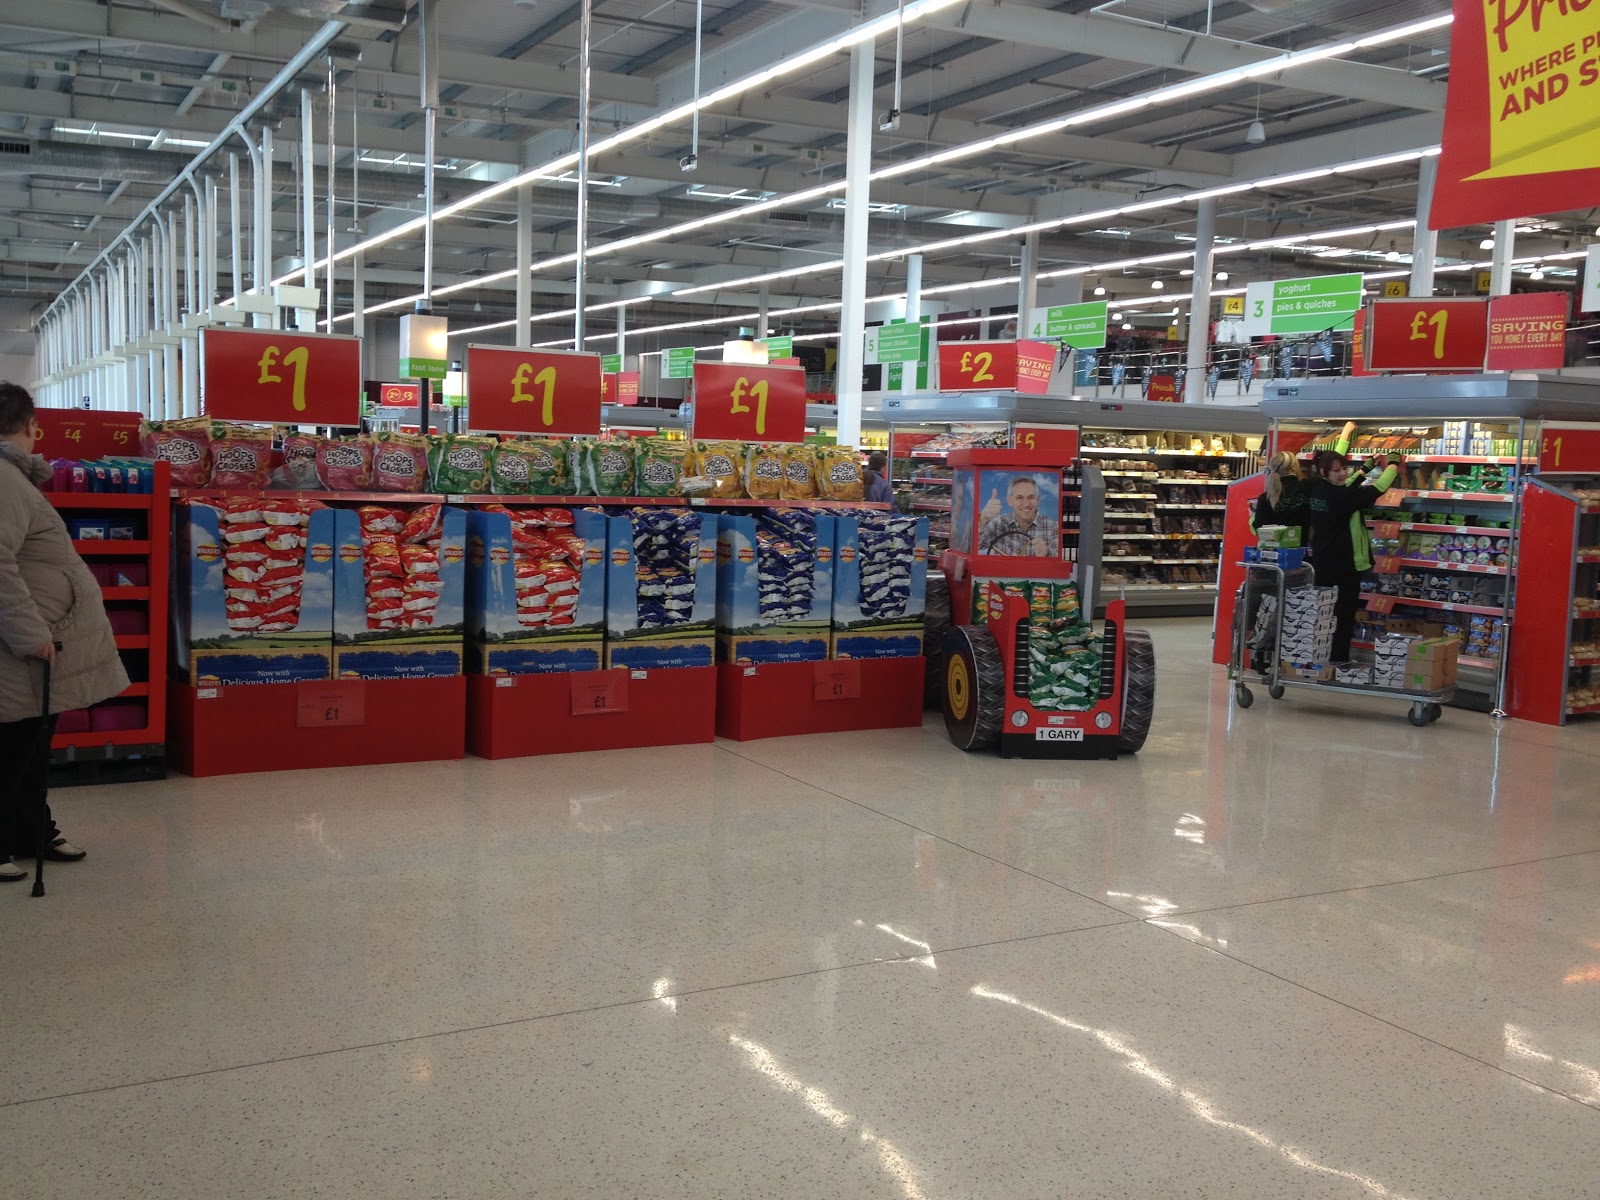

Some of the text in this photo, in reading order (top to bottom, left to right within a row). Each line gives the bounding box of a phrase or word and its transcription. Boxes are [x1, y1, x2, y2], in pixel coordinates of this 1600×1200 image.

[1499, 31, 1600, 90] WHERE P
[1500, 55, 1600, 121] AND S
[1279, 283, 1311, 295] yoghurt
[1228, 301, 1239, 310] £4
[1253, 300, 1264, 318] 3
[1277, 299, 1336, 312] pies & quiches
[1051, 310, 1063, 318] milk
[1034, 323, 1041, 337] 4
[1049, 324, 1067, 333] butter
[1074, 322, 1096, 331] spreads
[1491, 321, 1564, 333] SAVING
[1409, 309, 1448, 359] £1
[1505, 334, 1525, 344] MONEY
[1527, 332, 1548, 343] EVERY
[869, 340, 874, 352] 5
[427, 364, 445, 372] lane
[960, 351, 994, 382] £2
[1017, 359, 1051, 371] AVING
[257, 345, 309, 411] £1
[404, 391, 412, 400] £3
[511, 363, 556, 426] £1
[730, 376, 768, 435] £1
[65, 429, 81, 443] £4
[113, 431, 128, 444] £5
[1016, 433, 1035, 450] £5
[159, 441, 195, 454] HOOPS
[289, 447, 317, 458] HOOP
[328, 449, 359, 457] HOOPS
[1542, 437, 1562, 466] £1
[219, 450, 254, 462] HOOPS
[325, 457, 362, 466] CROSSES
[383, 454, 412, 467] HOOPS
[450, 452, 481, 461] HOOPS
[217, 461, 256, 470] CROSSES
[380, 462, 413, 475] CROSSES
[645, 465, 672, 474] HOOPS
[499, 469, 527, 478] ROSSES
[643, 473, 674, 482] CROSSES
[222, 678, 263, 686] Delicious
[362, 672, 399, 680] Delicious
[594, 696, 606, 708] £1
[326, 707, 339, 720] £1
[1039, 730, 1080, 739] 1 GARY
